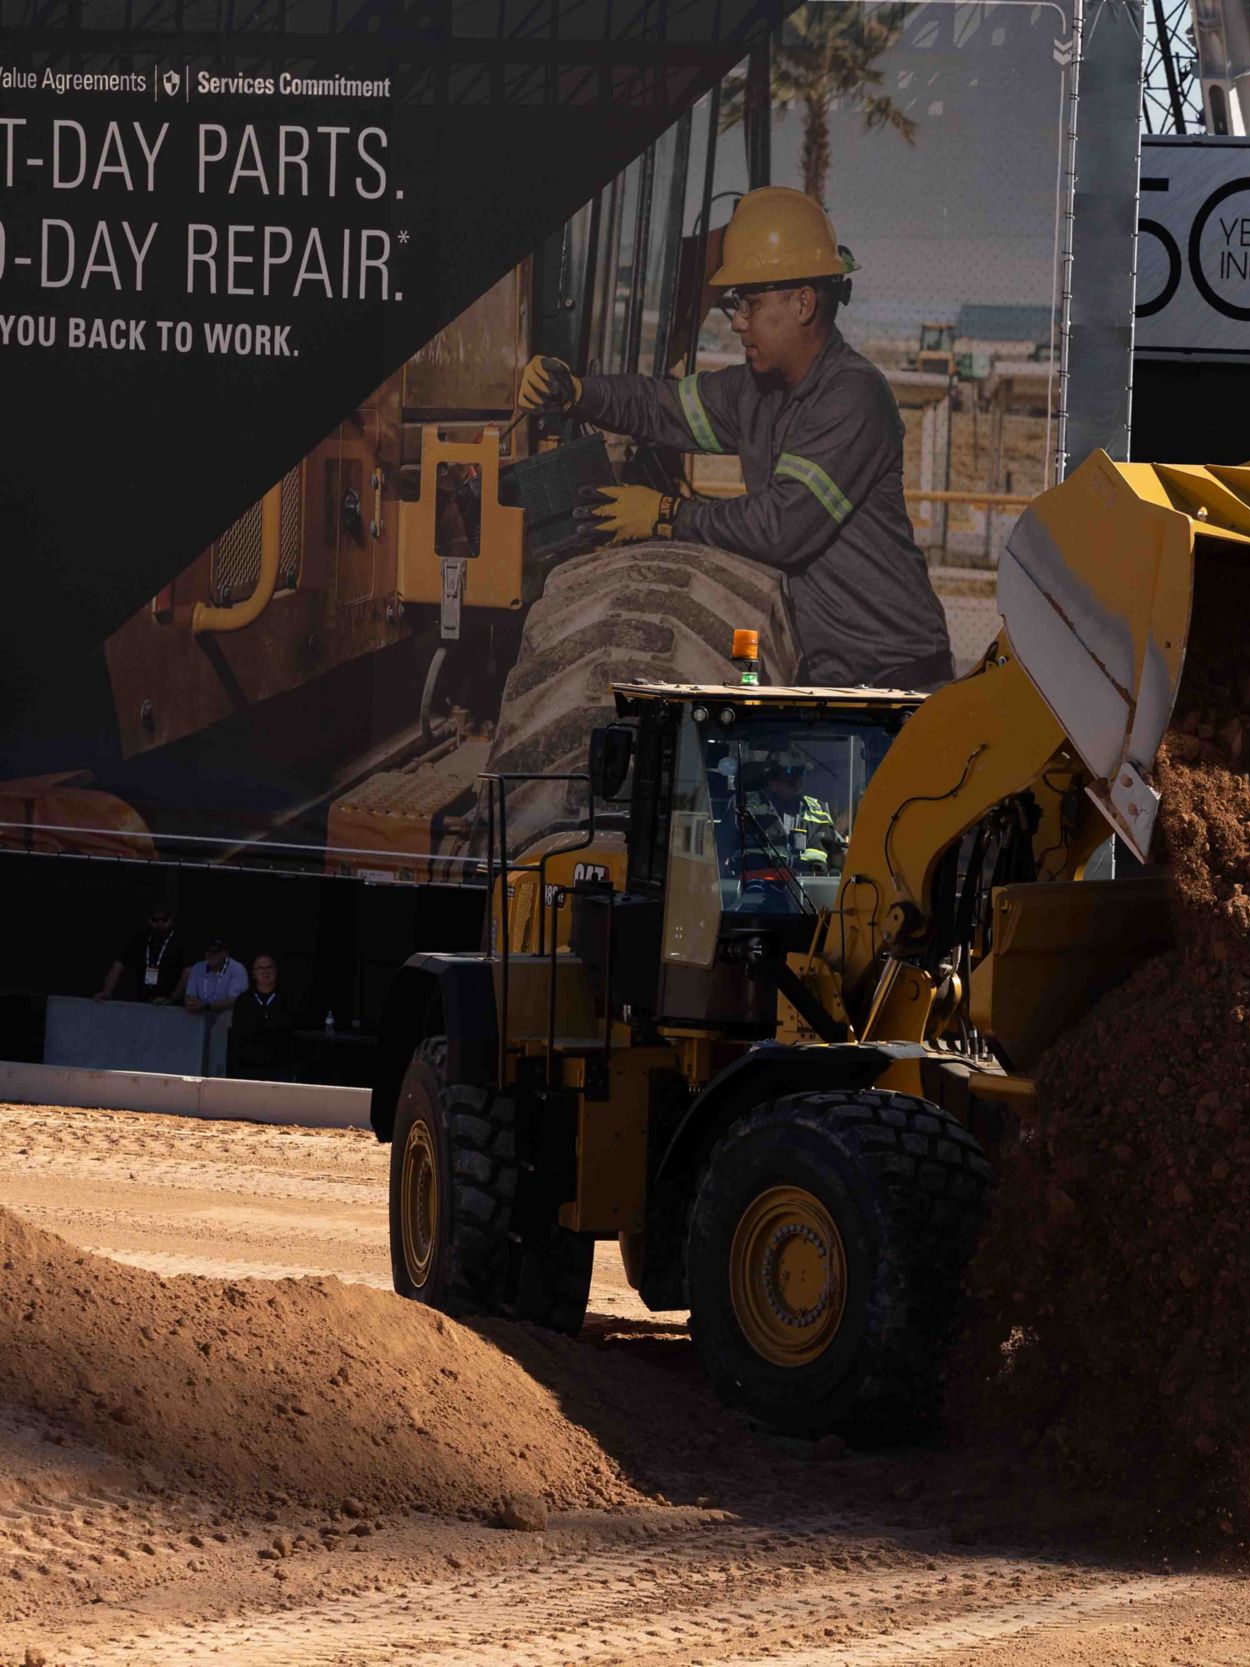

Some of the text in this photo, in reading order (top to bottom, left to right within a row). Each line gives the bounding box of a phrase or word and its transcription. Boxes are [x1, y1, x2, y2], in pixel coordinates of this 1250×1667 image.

[42, 67, 147, 95] Agreements
[197, 70, 275, 95] Services
[279, 73, 391, 98] Commitment
[0, 118, 404, 200] T-DAY PARTS.
[0, 218, 158, 292] -DAY
[0, 315, 299, 357] YOU BACK TO WORK.
